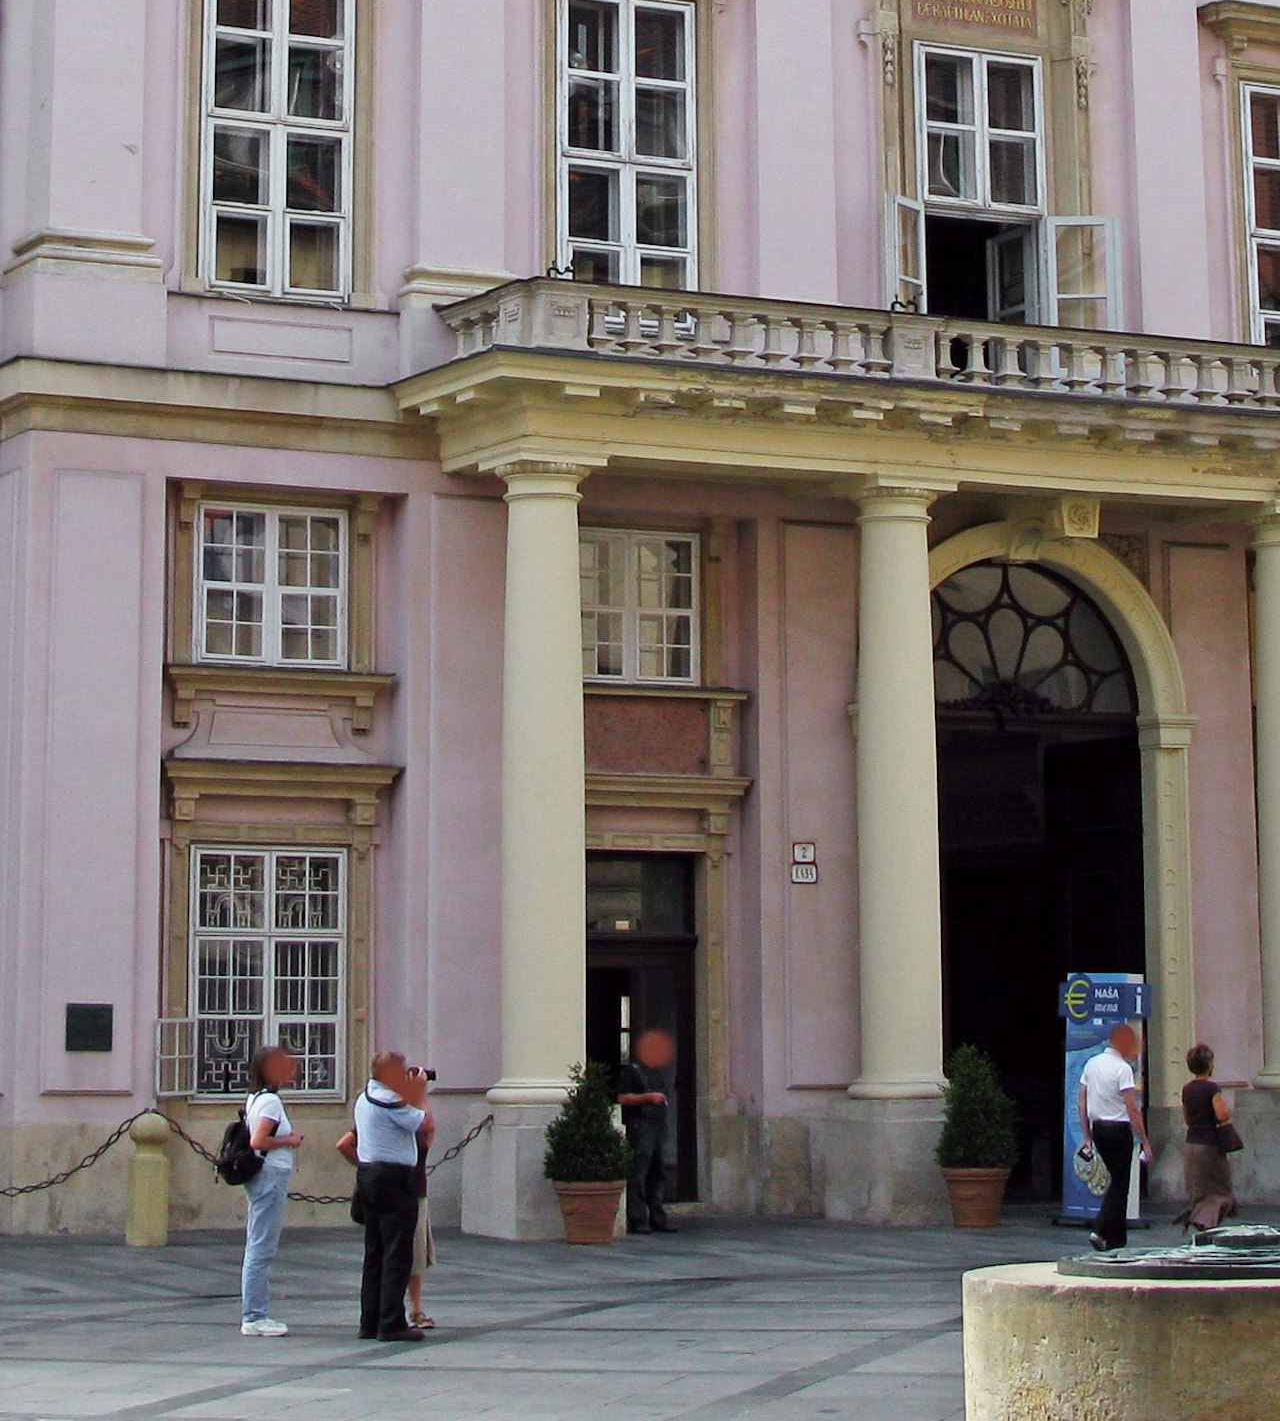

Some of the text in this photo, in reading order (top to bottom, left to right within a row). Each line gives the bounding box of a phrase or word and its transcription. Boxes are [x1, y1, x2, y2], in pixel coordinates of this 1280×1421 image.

[801, 846, 807, 859] 2
[1094, 986, 1119, 998] NAŠA
[1064, 979, 1090, 1019] €
[1135, 986, 1142, 1015] i
[1094, 1003, 1118, 1012] mena
